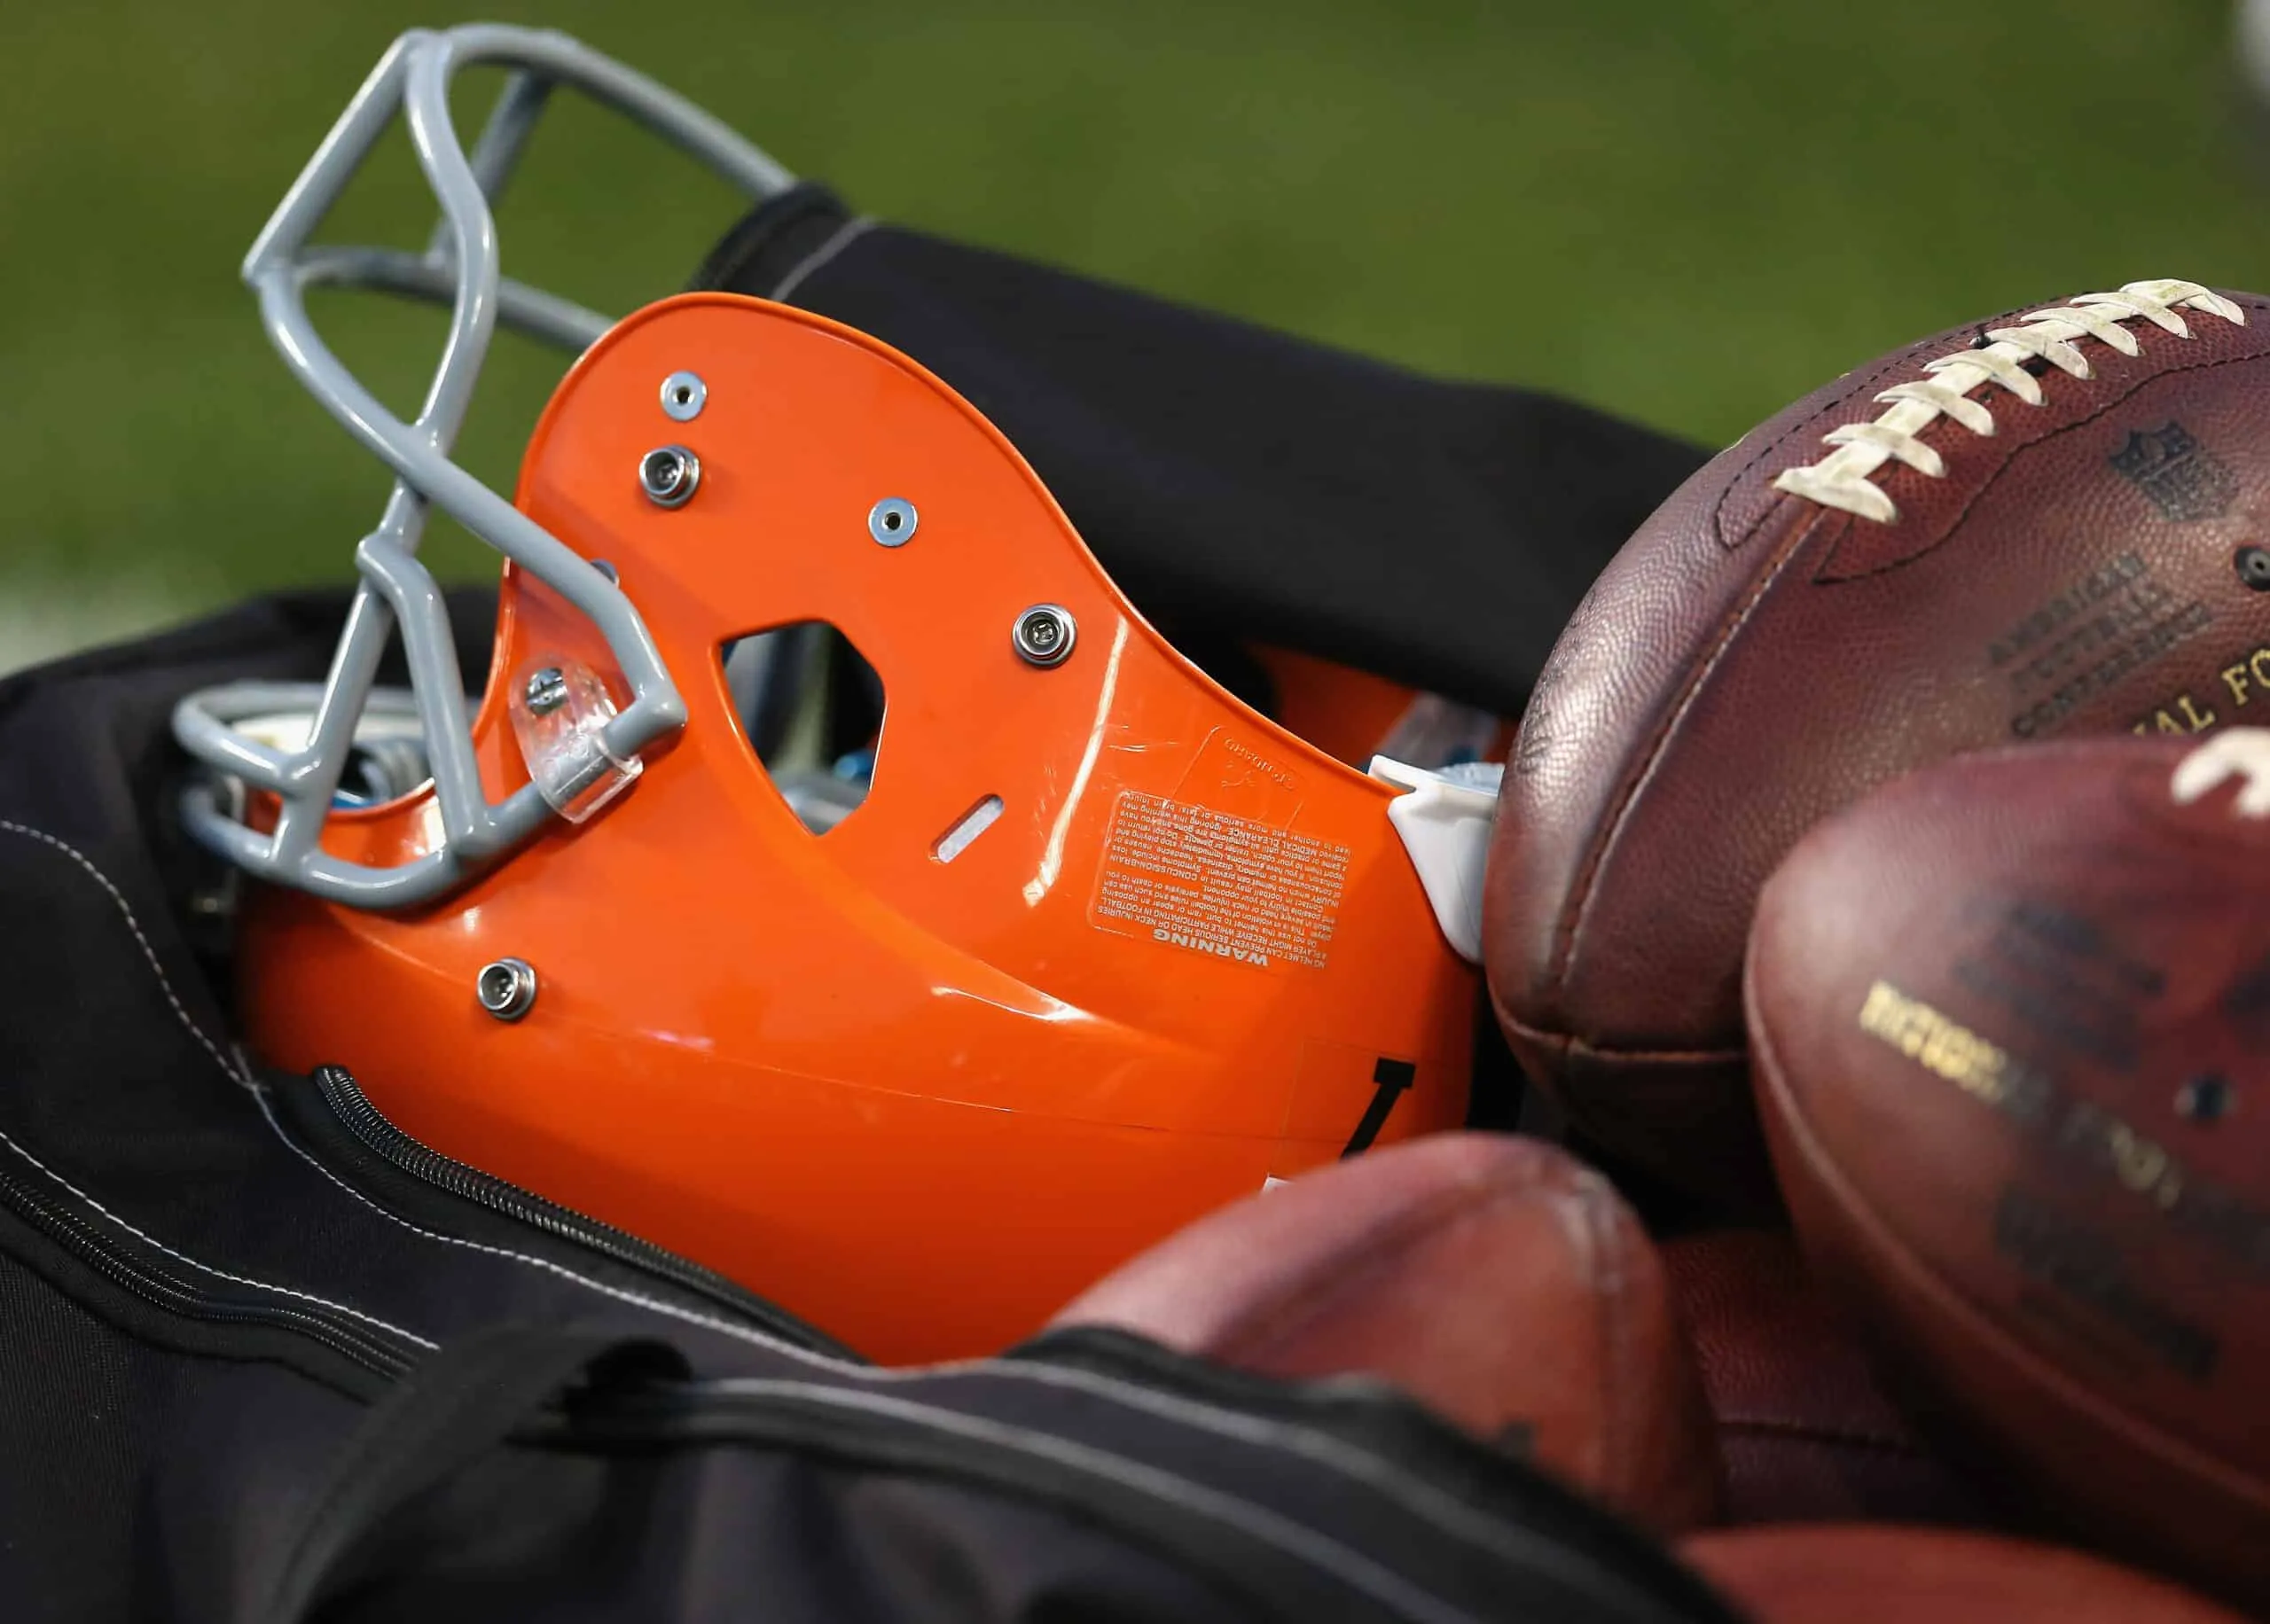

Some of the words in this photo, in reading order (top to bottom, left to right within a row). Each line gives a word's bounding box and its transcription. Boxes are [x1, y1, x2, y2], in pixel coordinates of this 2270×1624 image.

[2133, 696, 2215, 737] AL
[1280, 840, 1317, 856] MEDICAL
[1253, 888, 1283, 902] football
[1096, 904, 1133, 920] INJURIES
[1189, 899, 1218, 913] football
[1133, 913, 1156, 926] NECK
[1152, 909, 1209, 930] PARTICIPATING
[1233, 920, 1259, 933] helmet
[1170, 922, 1193, 935] HEAD
[1194, 928, 1229, 944] SERIOUS
[1209, 923, 1234, 936] WHILE
[1229, 937, 1265, 953] PREVENT
[1234, 929, 1268, 945] RECEIVE
[1268, 938, 1292, 951] MIGHT
[1151, 927, 1270, 966] WARNING
